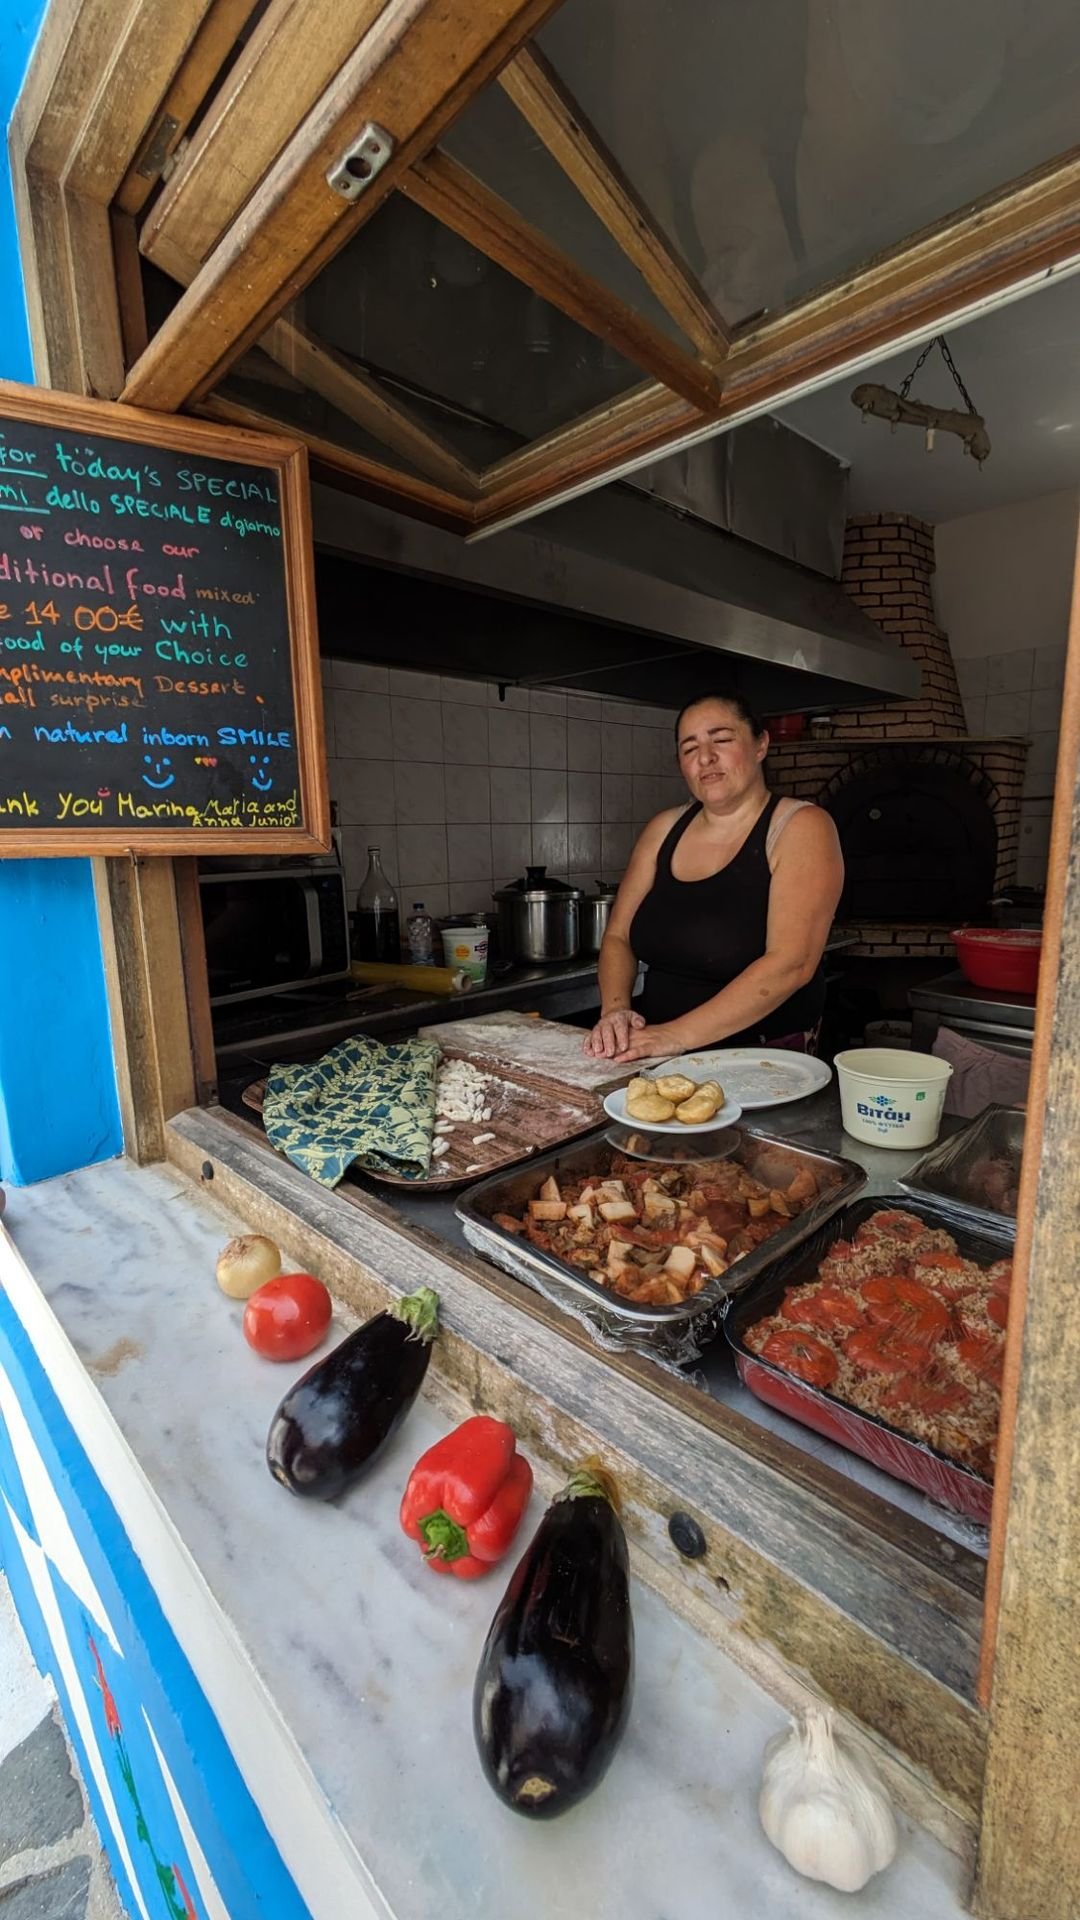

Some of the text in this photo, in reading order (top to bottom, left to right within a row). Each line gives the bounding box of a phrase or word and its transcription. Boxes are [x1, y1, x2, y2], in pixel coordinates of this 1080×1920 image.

[176, 470, 278, 504] SPECIAL
[46, 485, 100, 514] dello
[110, 493, 212, 525] SPECIALE
[19, 524, 201, 558] or choose our
[125, 568, 187, 601] food
[195, 587, 256, 605] mixed
[160, 609, 233, 640] with
[59, 637, 84, 661] of
[94, 643, 143, 665] your
[155, 640, 249, 668] Choice
[0, 685, 147, 713] all surprise
[33, 720, 128, 744] natural
[142, 726, 209, 748] inborn
[216, 726, 292, 748] SMILE
[204, 792, 259, 817] Maria
[263, 788, 297, 813] and
[192, 811, 298, 827] Anna Junior
